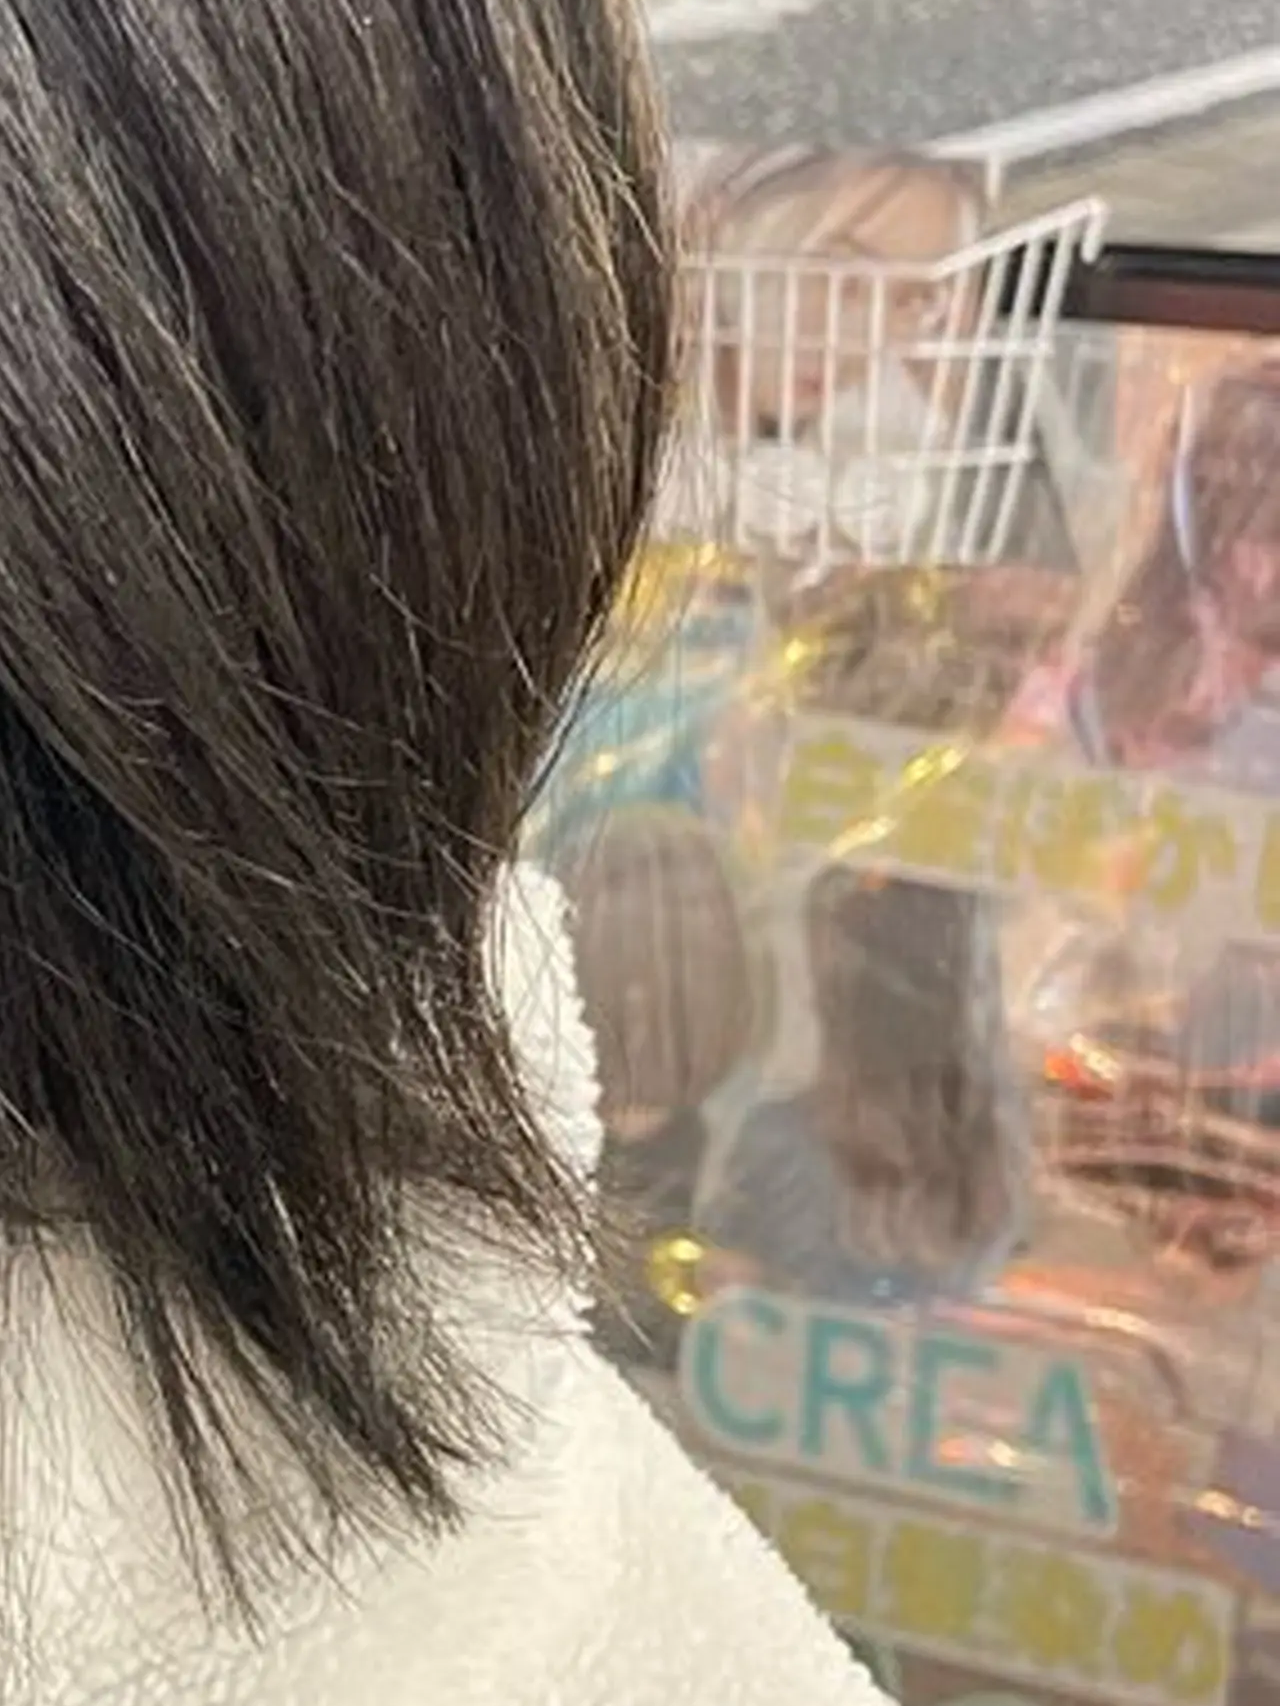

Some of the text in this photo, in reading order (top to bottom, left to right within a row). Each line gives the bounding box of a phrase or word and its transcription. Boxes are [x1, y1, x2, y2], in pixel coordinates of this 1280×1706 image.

[693, 1297, 1111, 1525] CREA
[740, 1483, 1228, 1705] 白髪染め
